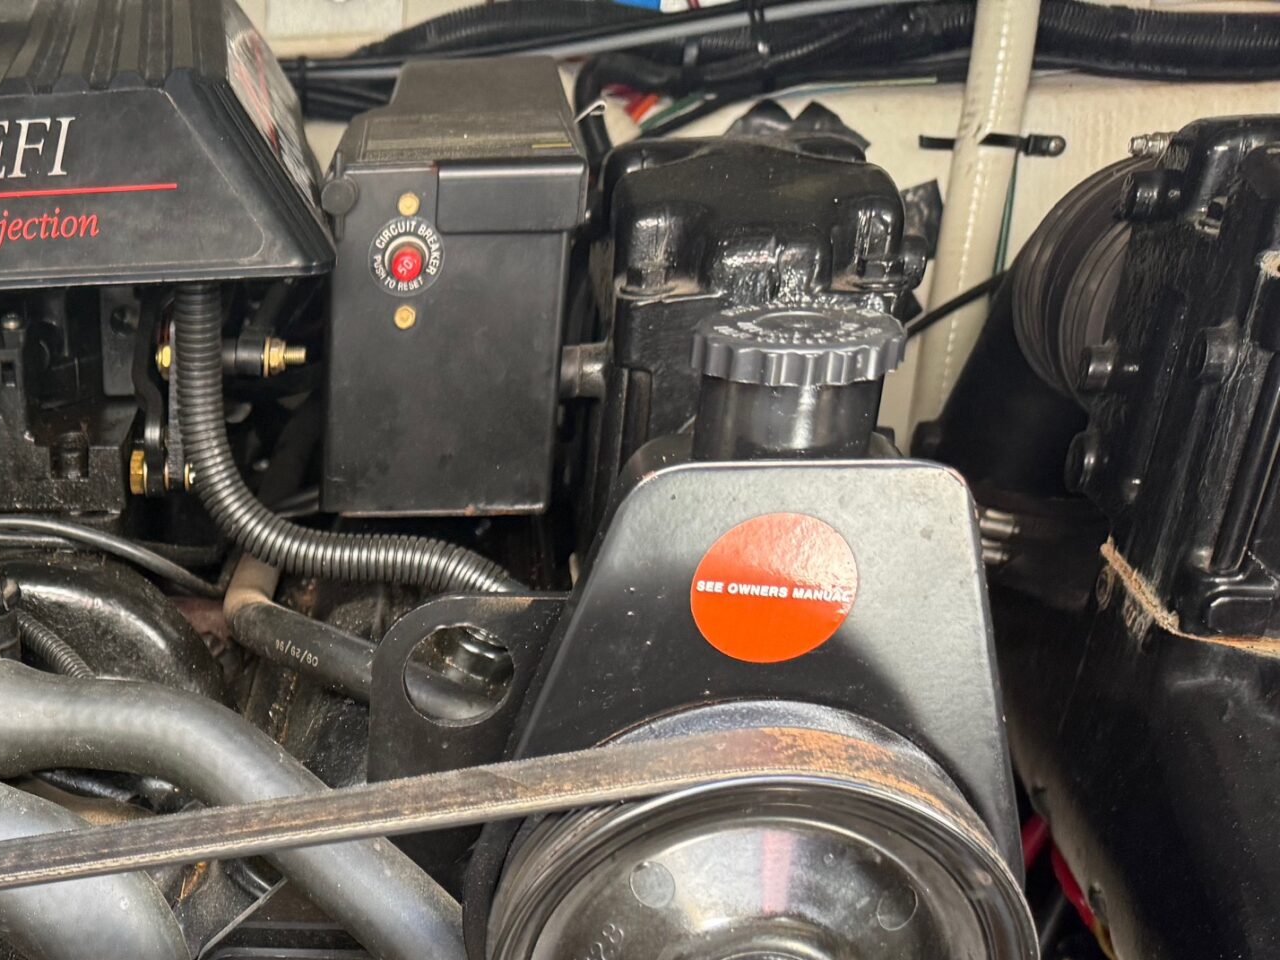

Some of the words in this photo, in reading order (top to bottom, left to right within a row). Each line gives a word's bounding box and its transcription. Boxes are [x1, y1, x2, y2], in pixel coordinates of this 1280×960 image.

[375, 219, 417, 249] CIRCUIT
[417, 223, 440, 276] BREAKER
[373, 254, 387, 280] PUSH
[384, 276, 396, 289] TO
[397, 275, 424, 292] RESET
[696, 580, 724, 593] SEE
[727, 582, 788, 598] OWNERS
[791, 588, 852, 602] MANUAL
